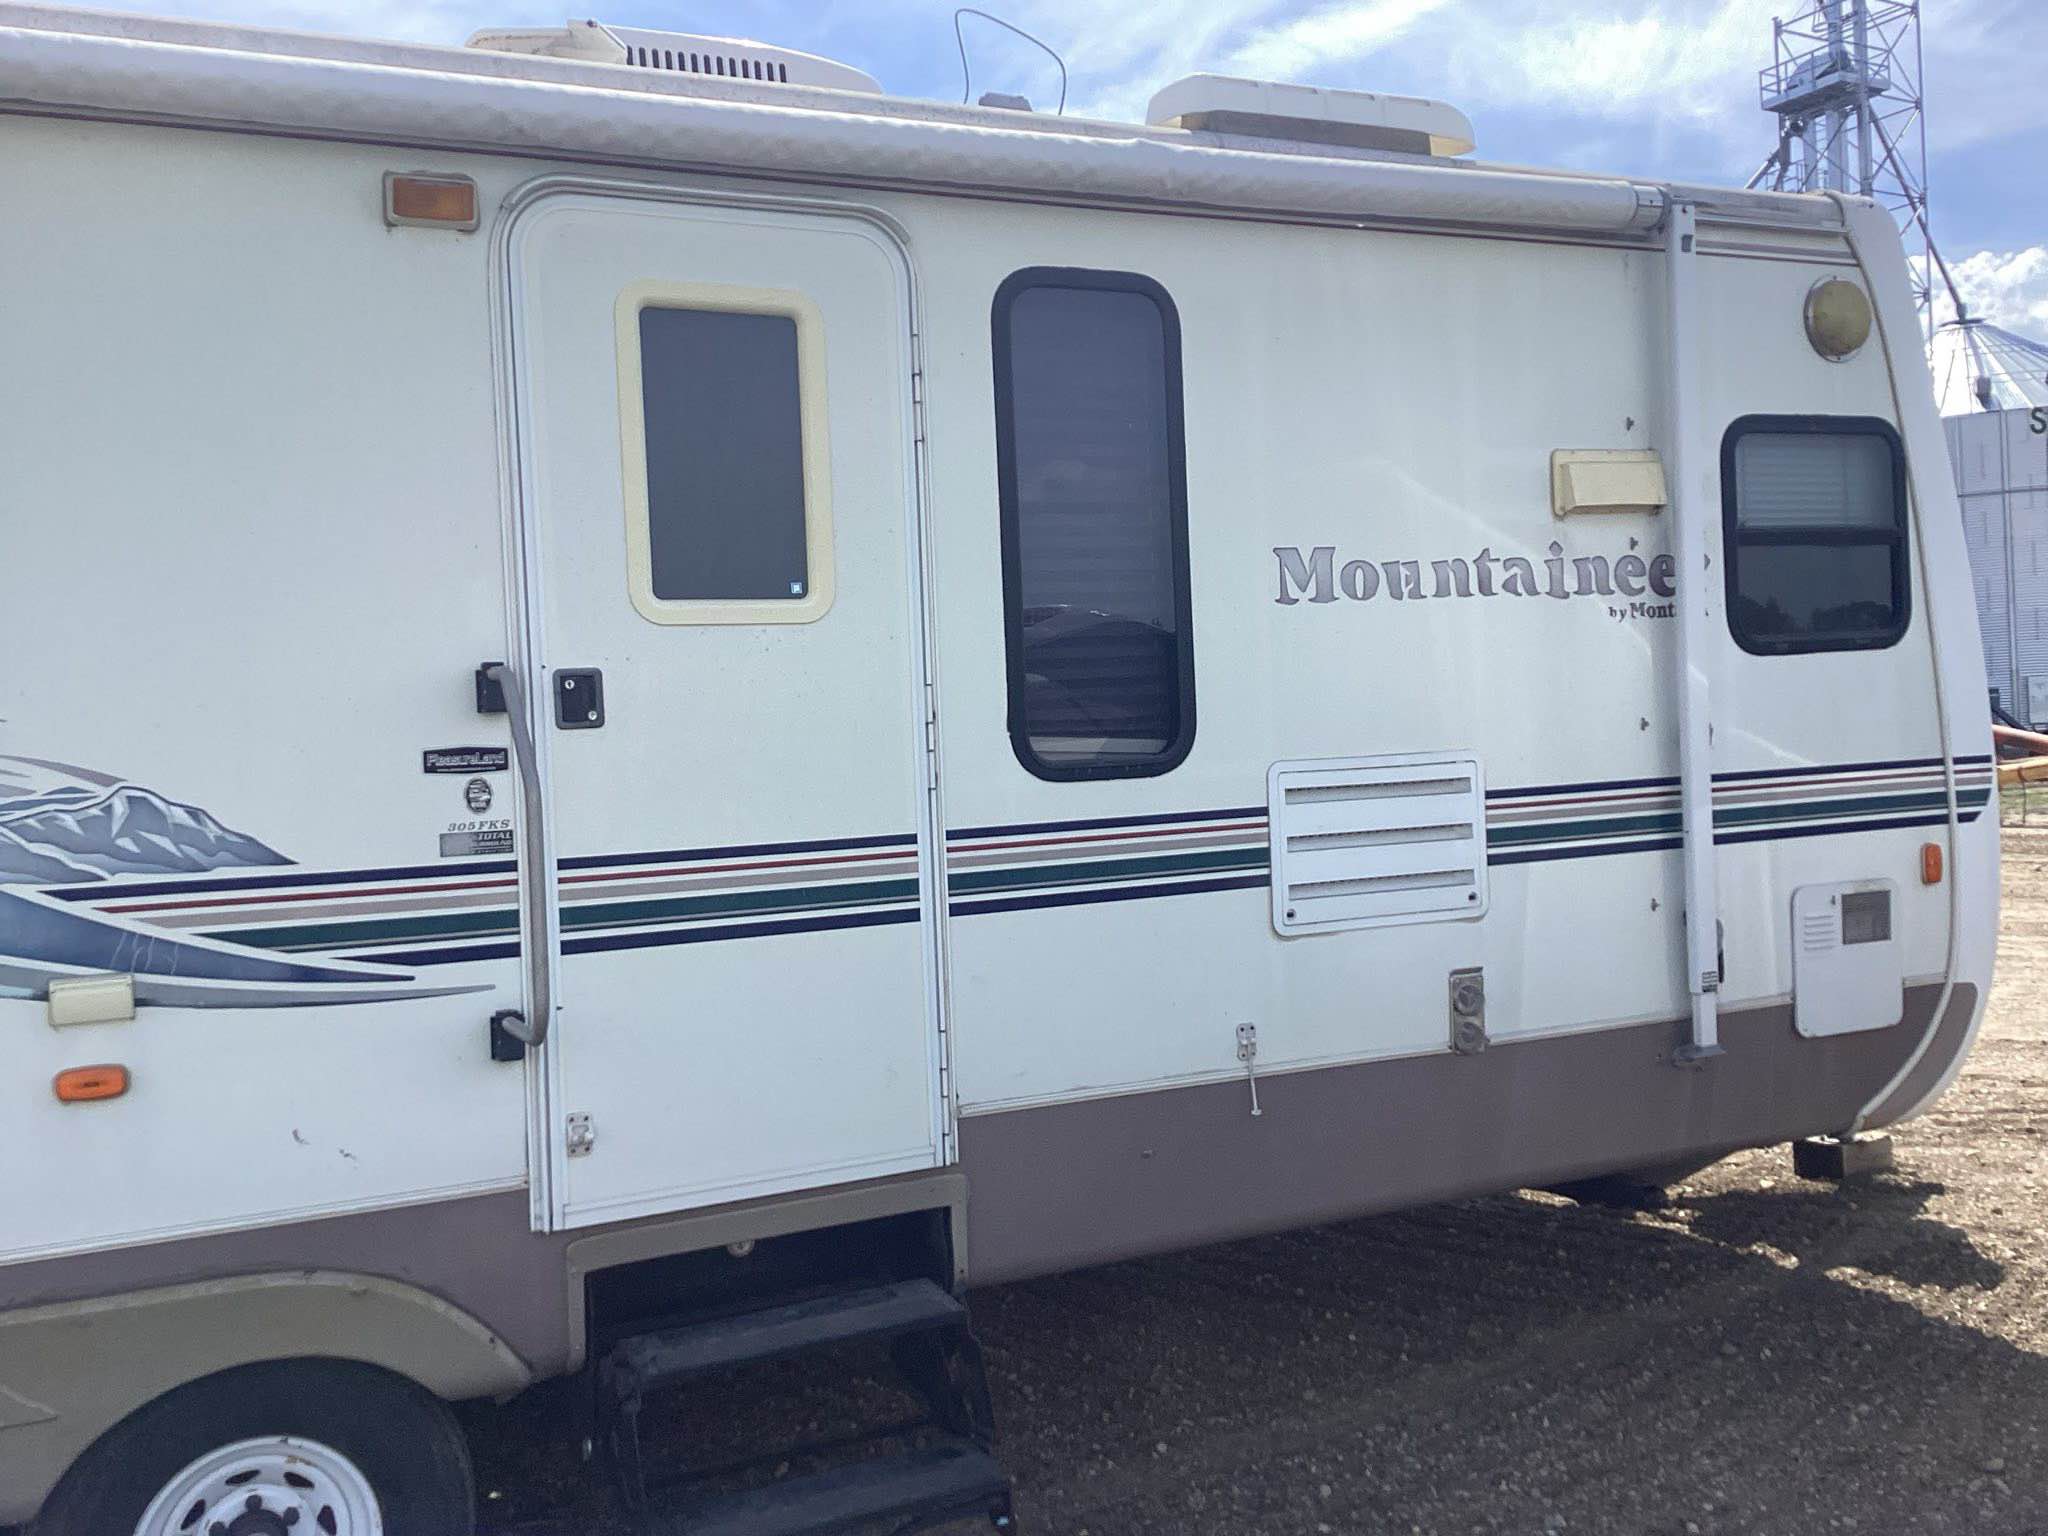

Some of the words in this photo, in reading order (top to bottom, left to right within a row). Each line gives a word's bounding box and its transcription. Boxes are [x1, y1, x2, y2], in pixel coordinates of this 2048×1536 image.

[1272, 540, 1711, 605] Mountainee
[1608, 606, 1627, 622] by
[1629, 602, 1677, 619] Mont
